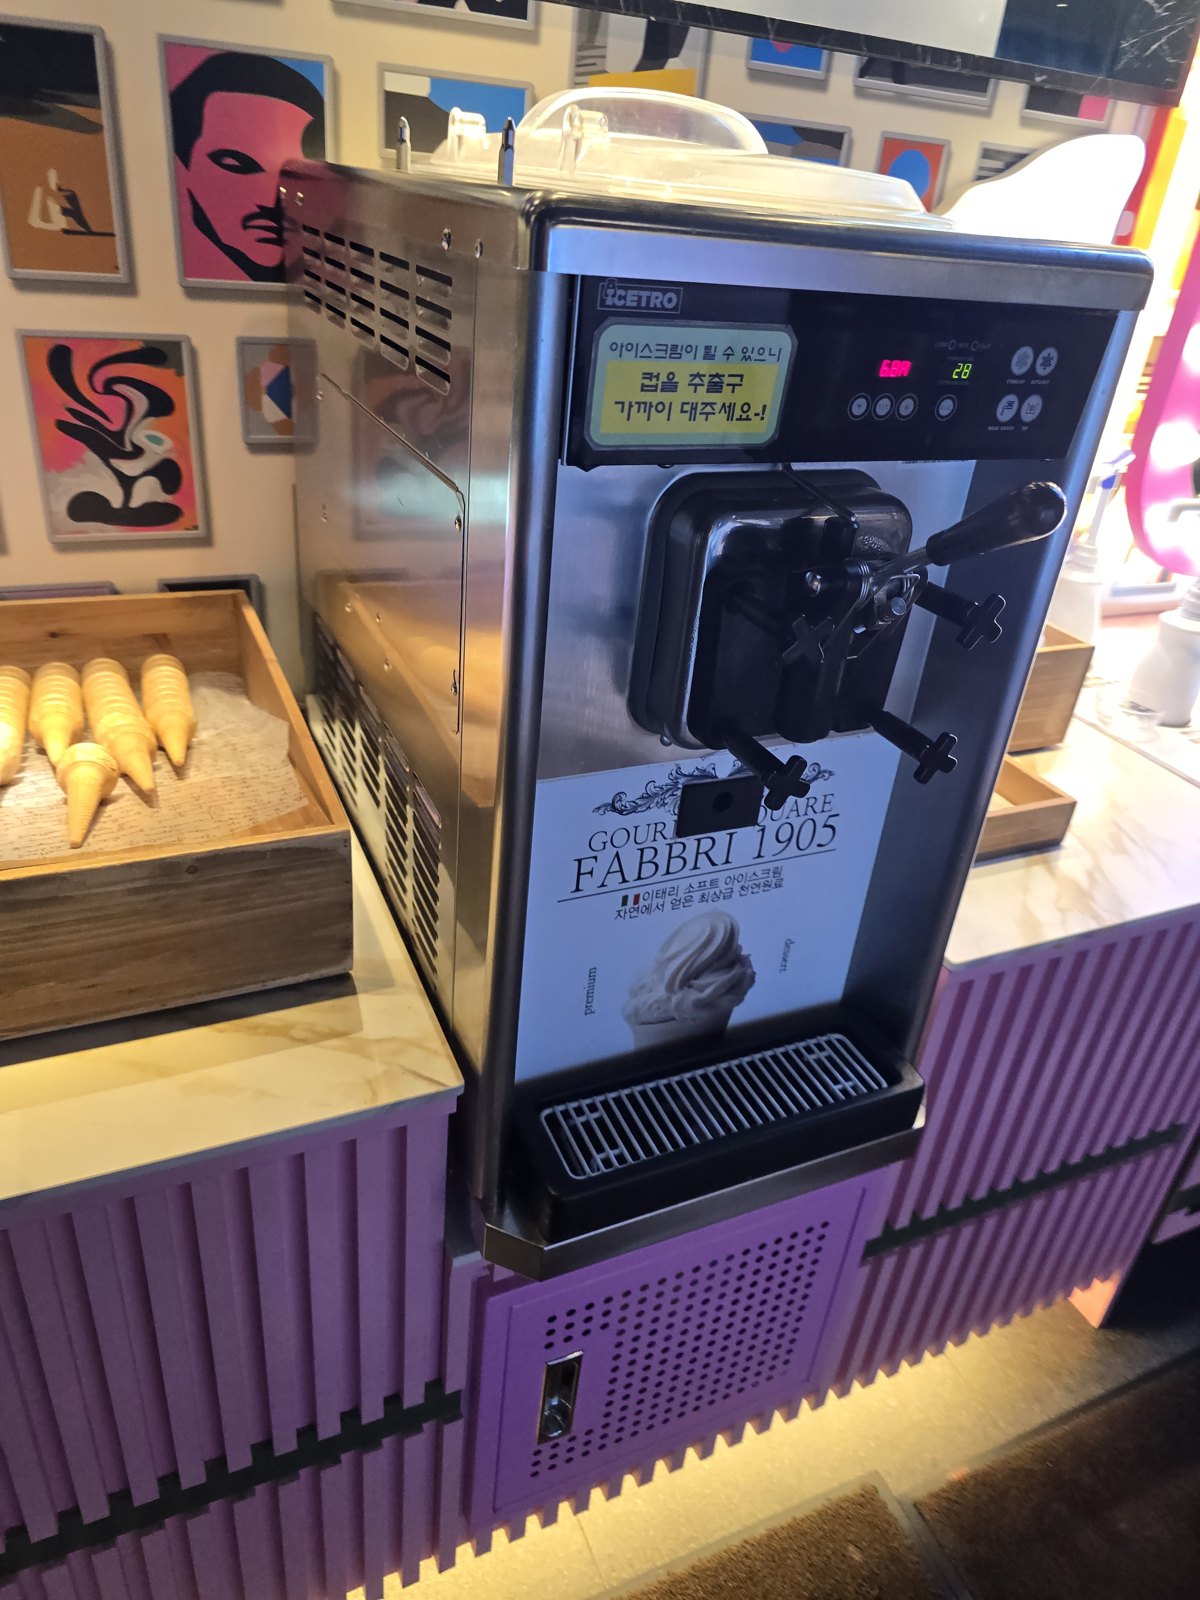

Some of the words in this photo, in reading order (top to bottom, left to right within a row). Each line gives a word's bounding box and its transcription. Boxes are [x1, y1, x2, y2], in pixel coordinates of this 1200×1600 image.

[609, 341, 699, 361] 아이스크림이
[722, 346, 736, 362] 수
[740, 346, 782, 363] 있으니
[639, 371, 680, 393] 컵을
[687, 371, 745, 394] 추출구
[952, 363, 973, 379] 28
[614, 401, 673, 422] 가까이
[588, 819, 677, 852] GOUR
[570, 831, 738, 893] FABBRI
[751, 814, 840, 859] 1905
[614, 902, 666, 921] 자연에서
[670, 894, 695, 911] 얻은
[697, 887, 734, 904] 최상급
[738, 877, 784, 897] 천연원료
[642, 885, 679, 902] 이태리
[683, 878, 720, 895] 소프트
[724, 865, 783, 887] 아이스크림
[584, 966, 597, 1016] premium
